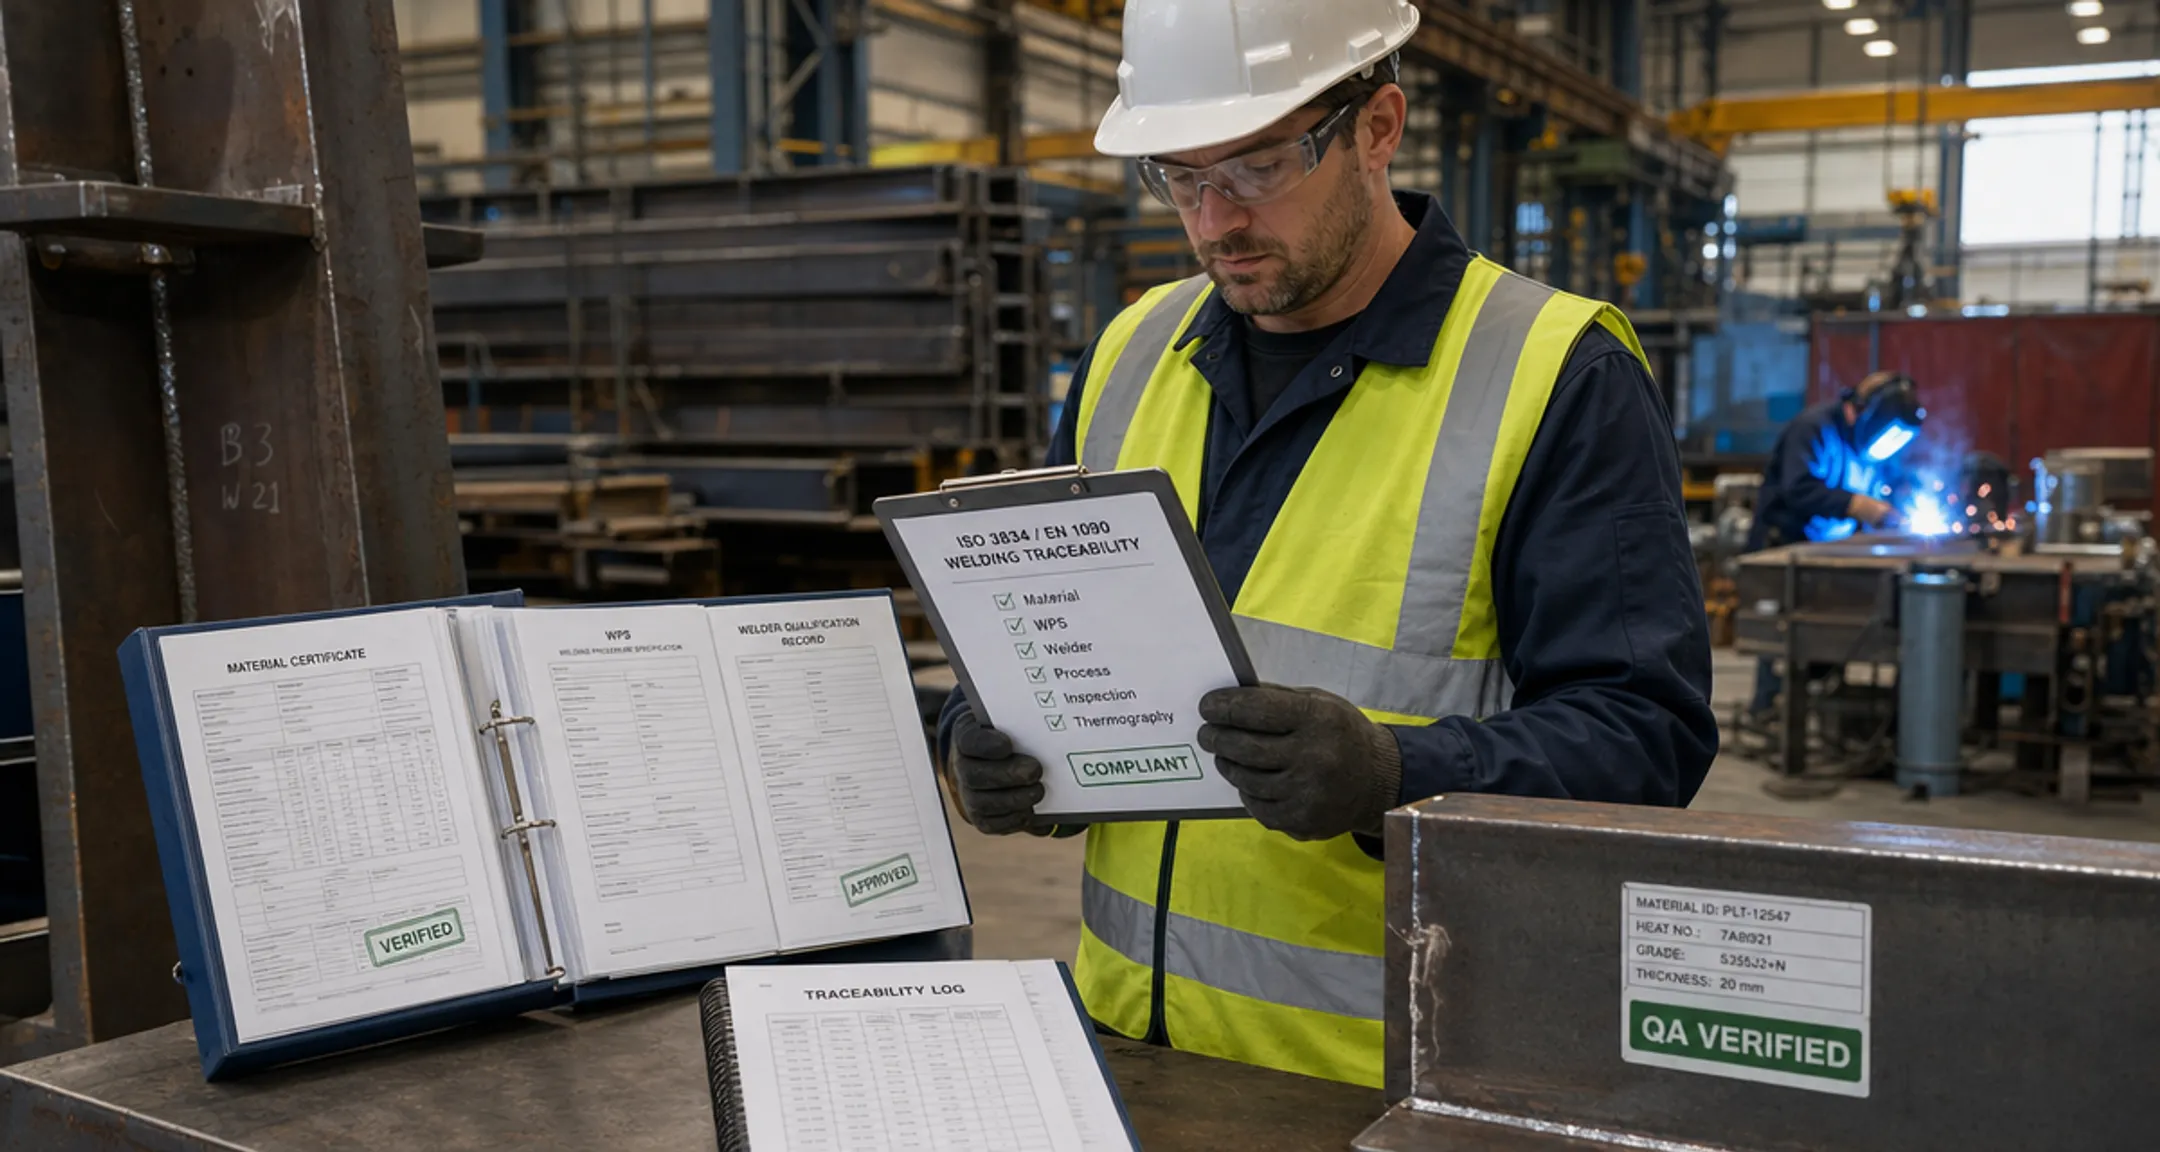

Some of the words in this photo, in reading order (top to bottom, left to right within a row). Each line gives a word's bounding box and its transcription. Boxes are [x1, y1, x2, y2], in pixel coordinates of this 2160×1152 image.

[221, 422, 242, 466] B
[253, 422, 273, 467] 3
[252, 481, 280, 514] 21
[956, 533, 986, 549] ISO
[989, 528, 1031, 546] 3834
[1043, 525, 1067, 540] EN
[1071, 520, 1111, 537] 1090
[944, 550, 1021, 570] WELDING
[1023, 537, 1141, 563] TRACEABILITY
[1022, 588, 1081, 607] Material
[737, 622, 783, 635] WELDER
[784, 617, 861, 633] QUALIFICATION
[1033, 616, 1069, 632] WPS
[604, 629, 632, 641] WPS
[781, 634, 826, 647] RECORD
[1043, 641, 1094, 656] Welder
[226, 656, 289, 674] MATERIAL
[289, 647, 367, 668] CERTIFICATE
[1053, 666, 1112, 681] Process
[1063, 687, 1138, 705] Inspection
[1072, 709, 1175, 729] Thermography
[1082, 755, 1189, 778] COMPLIANT
[850, 865, 911, 898] APPROVED
[1635, 896, 1699, 915] MATERIAL
[1701, 903, 1720, 916] ID:
[1635, 919, 1670, 935] HEAT
[378, 921, 453, 954] VERIFIED
[1635, 966, 1712, 988] THICKNESS:
[1719, 976, 1737, 991] 20
[1738, 979, 1765, 994] mm
[803, 985, 925, 1001] TRACEABILITY
[930, 983, 966, 996] LOG
[1641, 1015, 1690, 1047] QA
[1696, 1021, 1852, 1069] VERIFIED
